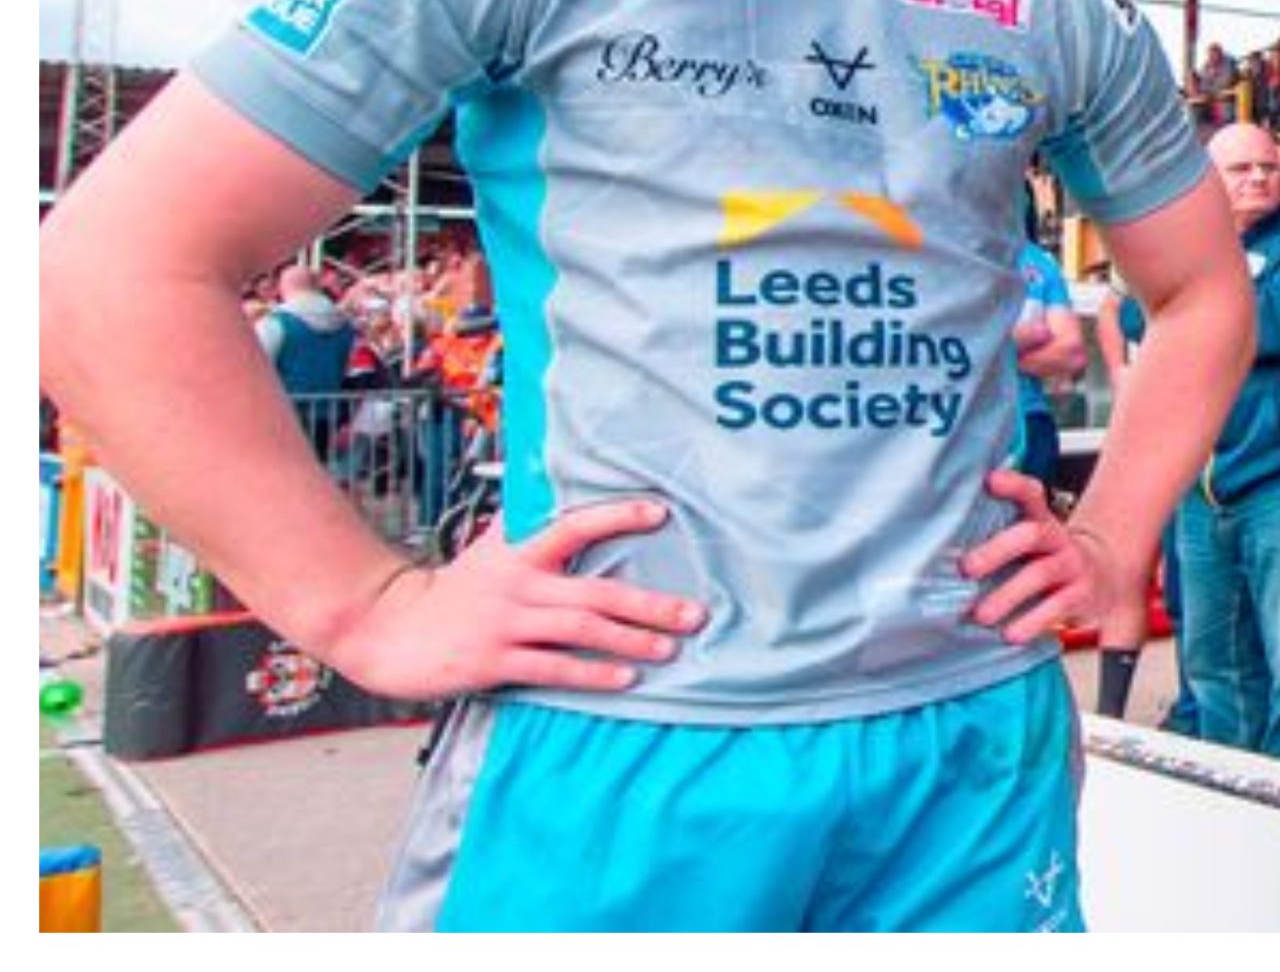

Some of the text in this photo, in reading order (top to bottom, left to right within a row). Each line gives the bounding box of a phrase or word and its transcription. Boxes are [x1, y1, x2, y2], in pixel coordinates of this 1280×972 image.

[810, 97, 877, 125] OXEN
[716, 259, 917, 309] Leeds
[715, 319, 972, 380] Building
[714, 380, 963, 437] Society
